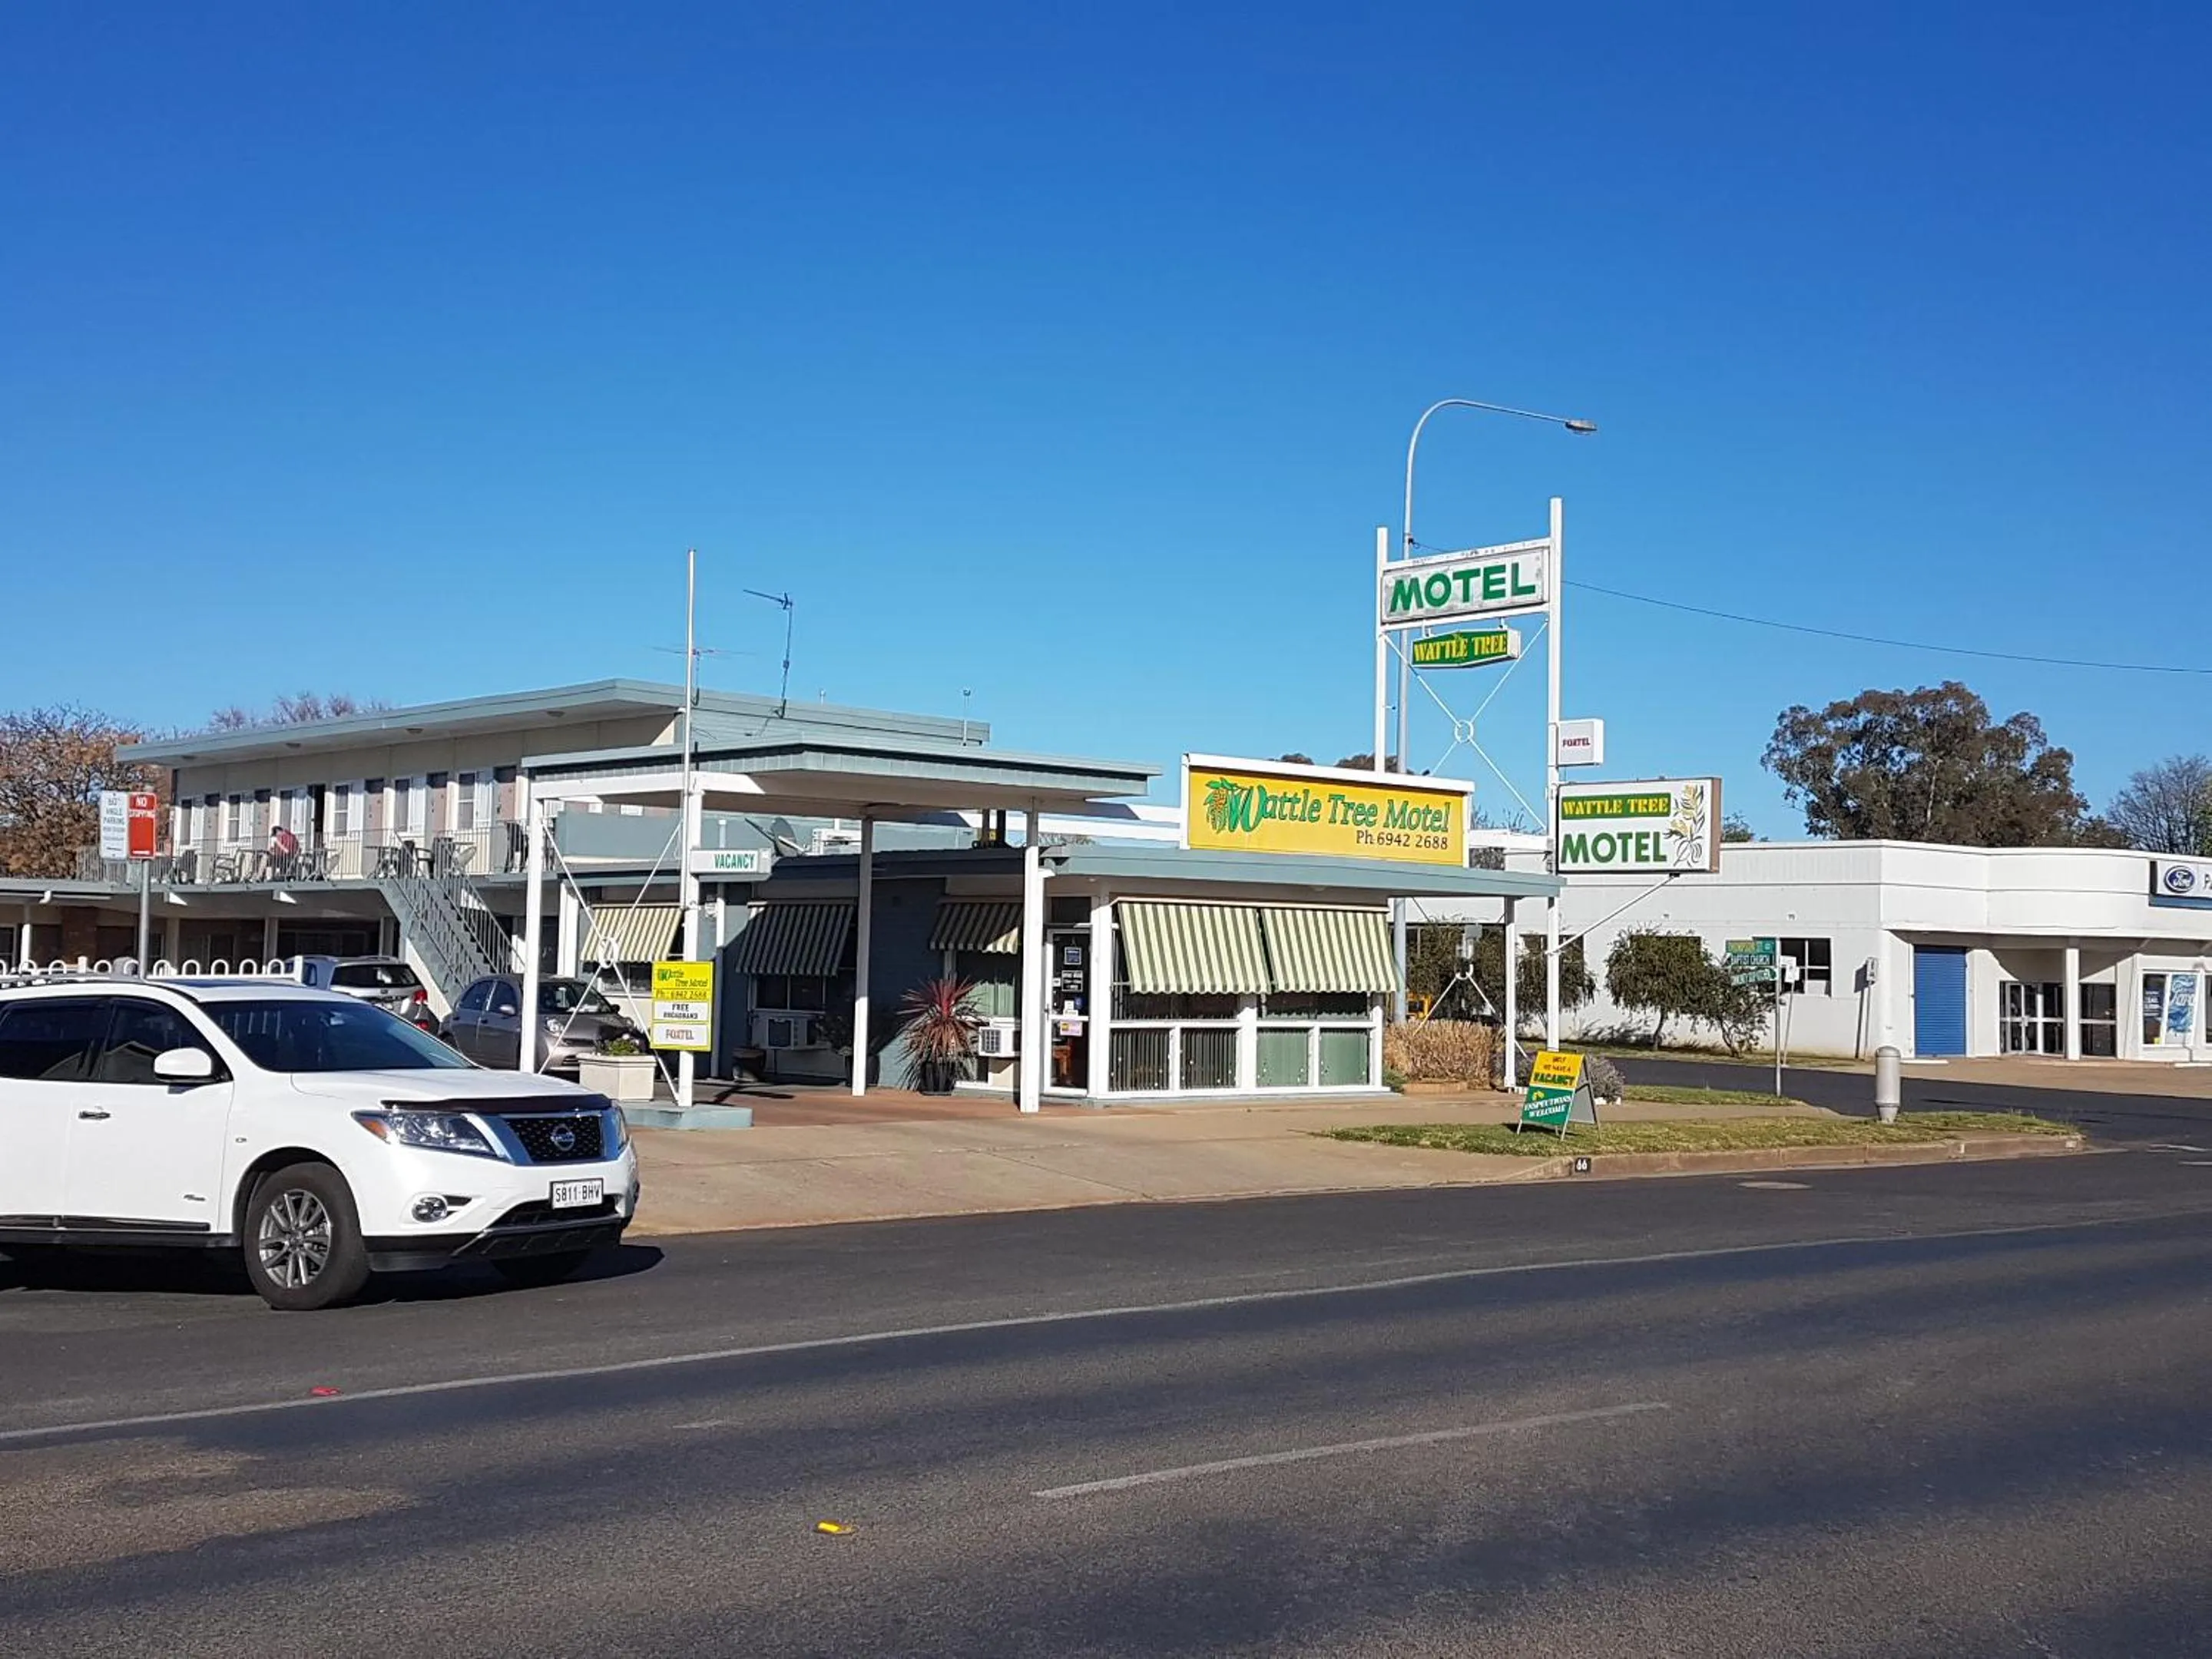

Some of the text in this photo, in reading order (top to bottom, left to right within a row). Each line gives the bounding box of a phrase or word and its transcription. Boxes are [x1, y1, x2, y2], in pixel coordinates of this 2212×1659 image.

[1389, 562, 1536, 613] MOTEL
[1413, 633, 1507, 662] WATTLE TREE
[1562, 737, 1591, 747] FOXTEL
[135, 797, 147, 807] NO
[1228, 784, 1451, 833] Wattle Tree Motel
[1562, 797, 1668, 815] WATTLE TREE
[1377, 832, 1410, 847] 6942
[1416, 834, 1448, 850] 2688
[1561, 832, 1667, 863] MOTEL
[714, 853, 755, 869] VACANCY
